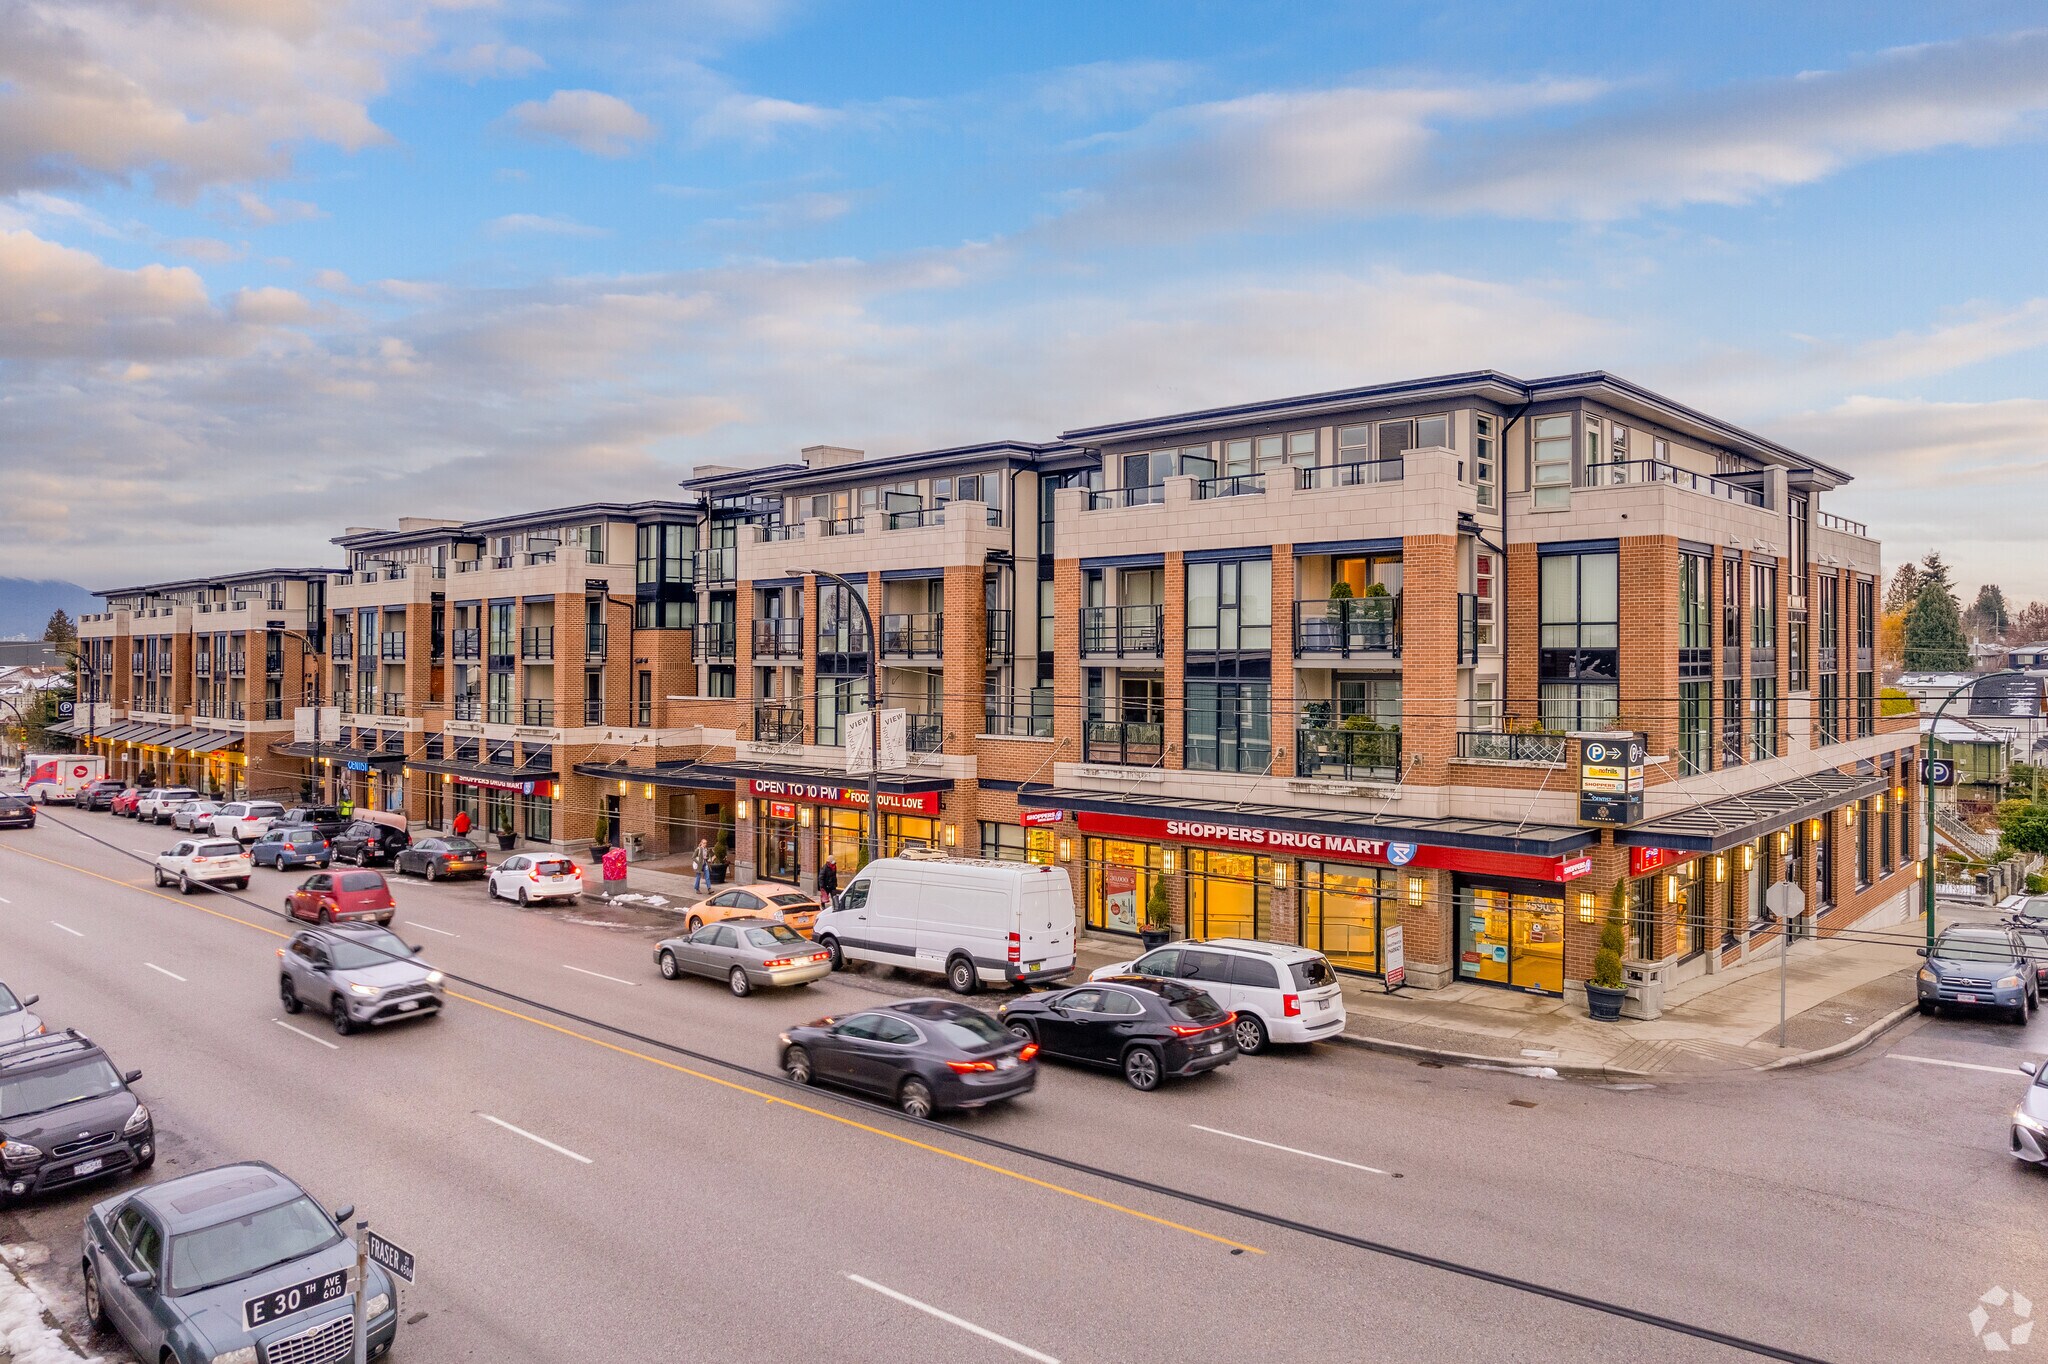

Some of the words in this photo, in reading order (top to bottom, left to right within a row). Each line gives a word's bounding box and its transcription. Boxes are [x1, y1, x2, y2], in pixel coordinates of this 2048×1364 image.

[849, 716, 869, 730] VIEW
[884, 713, 903, 725] VIEW
[755, 780, 784, 794] OPEN
[787, 783, 803, 796] TO
[807, 785, 817, 798] 10
[820, 787, 837, 800] PM
[877, 795, 900, 806] OU'LL
[902, 798, 923, 808] LOVE
[1166, 821, 1265, 844] SHOPPERS
[1269, 831, 1321, 850] DRUG
[1325, 837, 1384, 855] MART
[371, 1236, 399, 1270] FRASER
[400, 1264, 412, 1278] 4500
[253, 1300, 265, 1323] E
[274, 1289, 301, 1315] 30
[304, 1283, 316, 1295] TH
[324, 1274, 341, 1289] AVE
[323, 1285, 342, 1300] 600
